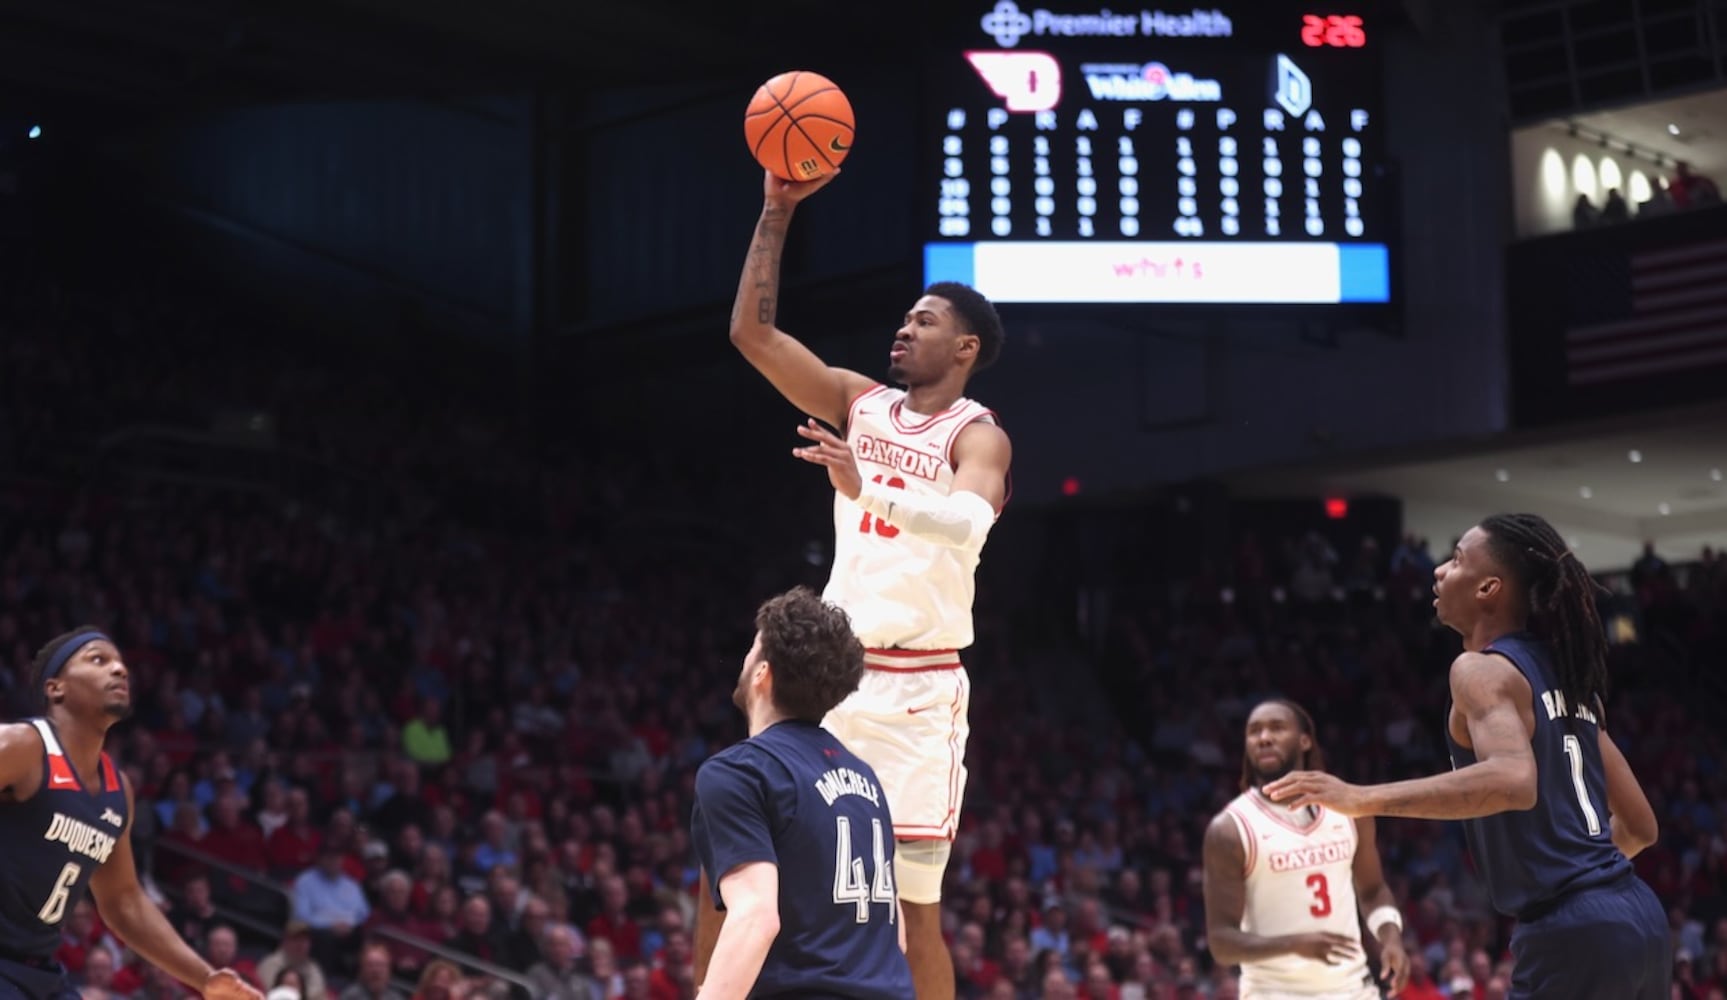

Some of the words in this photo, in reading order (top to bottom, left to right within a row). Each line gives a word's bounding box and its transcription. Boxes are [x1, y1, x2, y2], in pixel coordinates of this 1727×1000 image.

[1032, 9, 1138, 36] Premier
[1142, 9, 1233, 36] Health
[1301, 14, 1367, 47] 2:26
[857, 434, 944, 482] DAYTON
[1563, 734, 1600, 837] 1
[833, 816, 896, 925] 44
[1269, 840, 1351, 873] DAYTON
[37, 861, 81, 925] 6
[1306, 872, 1332, 920] 3
